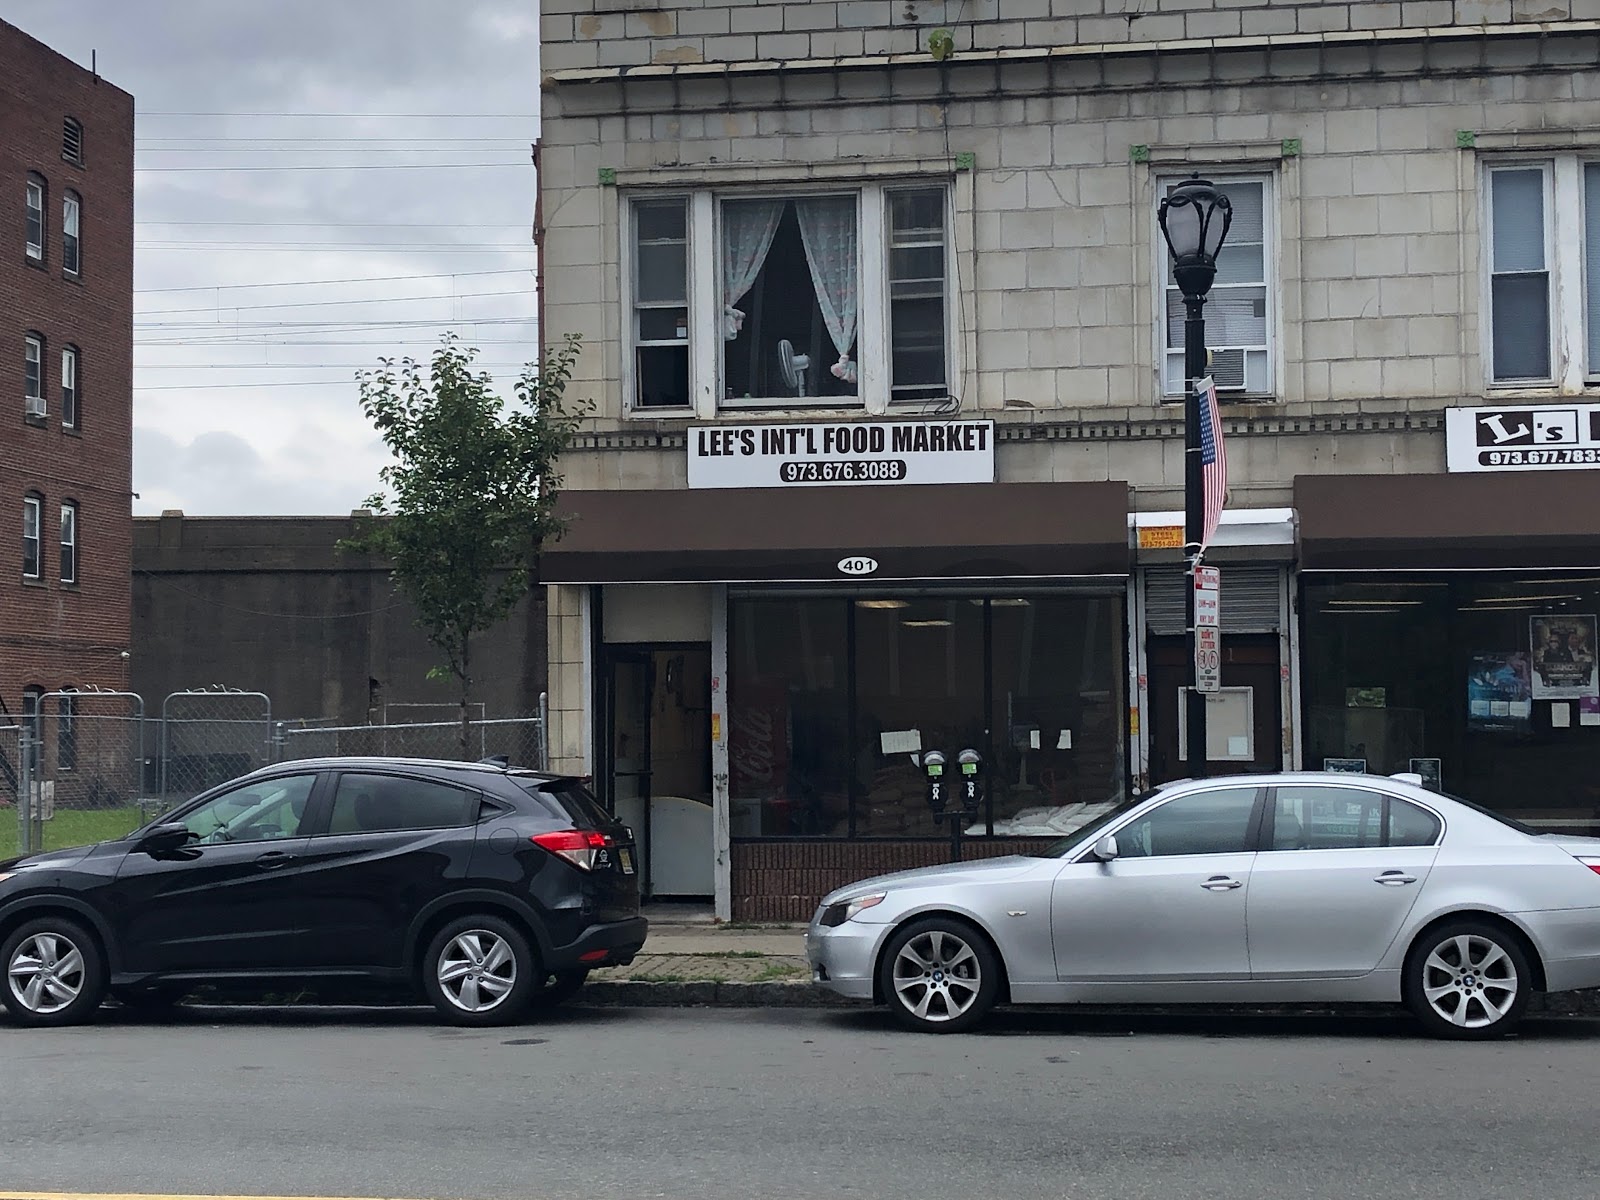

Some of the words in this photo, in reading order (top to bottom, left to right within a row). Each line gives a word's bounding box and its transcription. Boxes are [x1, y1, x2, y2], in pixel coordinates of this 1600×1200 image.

[1479, 414, 1564, 444] L's
[698, 429, 755, 457] LEE'S
[761, 427, 818, 455] INT'L
[823, 426, 885, 454] FOOD
[891, 424, 990, 453] MARKET
[786, 461, 900, 481] 973.676.3088
[843, 559, 875, 572] 401
[1201, 641, 1216, 649] LITTER
